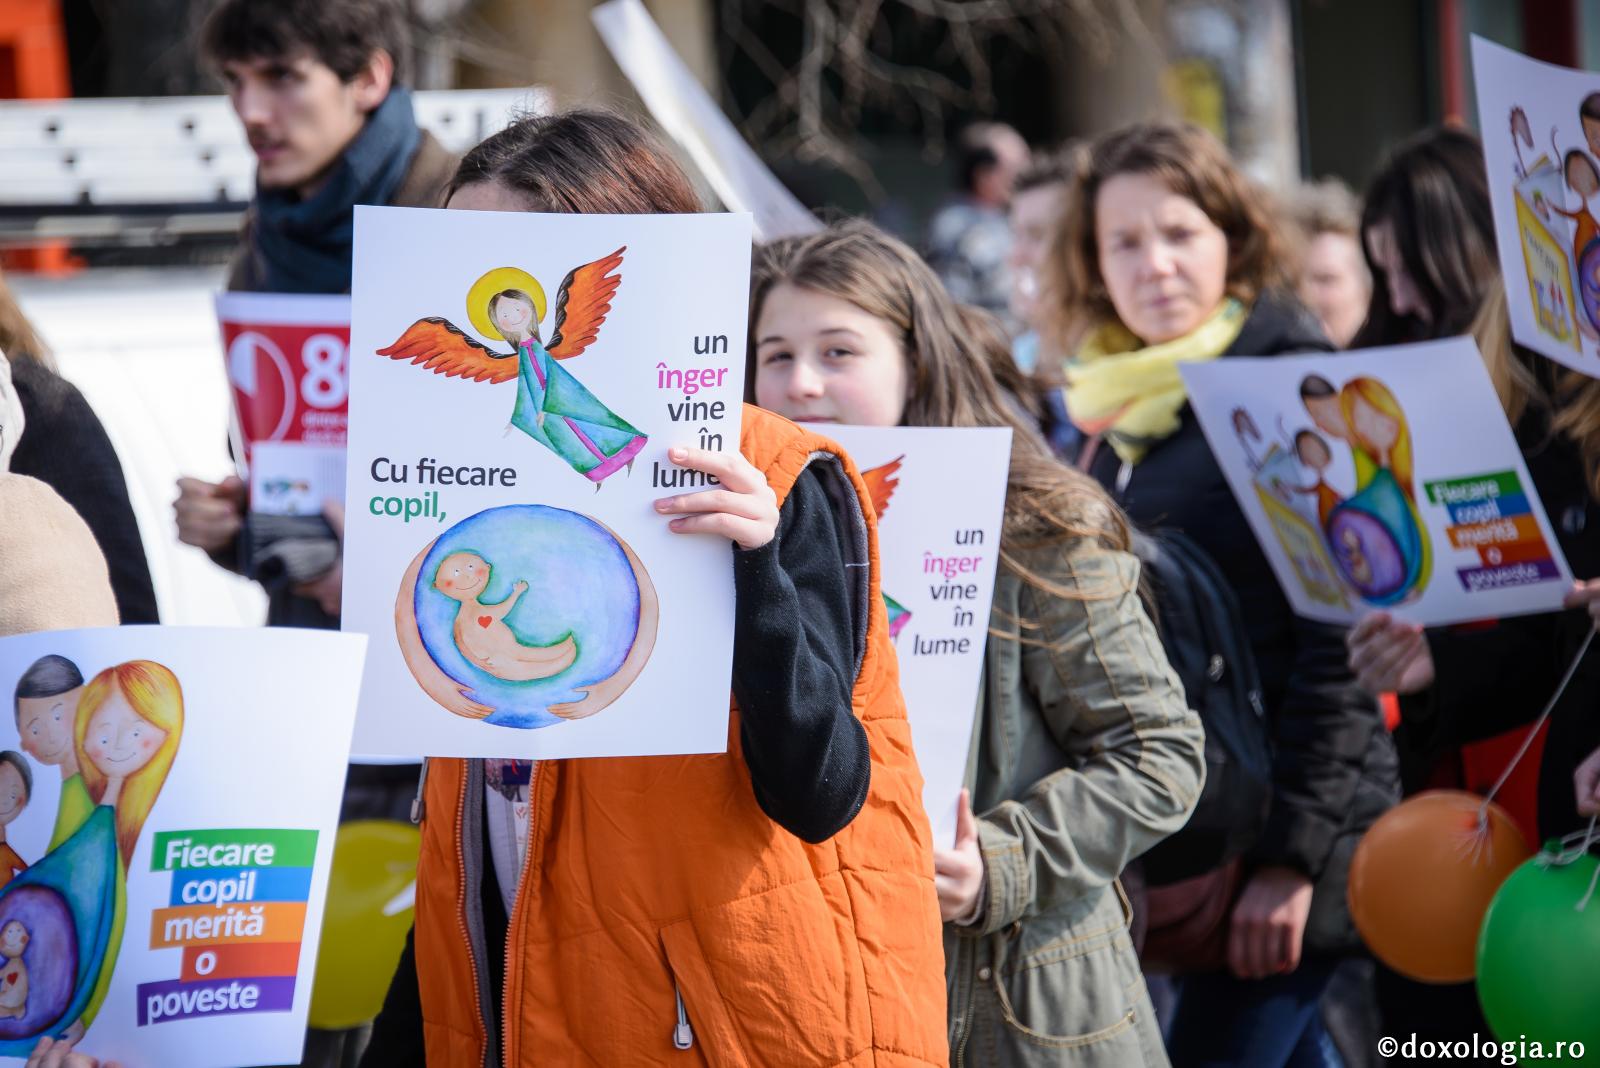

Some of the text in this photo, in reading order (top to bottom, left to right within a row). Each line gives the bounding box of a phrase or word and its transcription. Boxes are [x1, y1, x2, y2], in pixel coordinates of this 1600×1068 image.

[693, 334, 728, 355] un
[301, 333, 349, 409] 8
[656, 361, 729, 395] înger
[667, 396, 725, 422] vine
[698, 426, 723, 452] în
[370, 457, 517, 487] Cu fiecare
[1431, 479, 1500, 503] Fiecare
[369, 491, 447, 523] copil,
[1455, 498, 1501, 523] copil
[955, 529, 984, 545] un
[923, 550, 982, 579] înger
[1486, 546, 1503, 565] o
[930, 579, 977, 600] vine
[1467, 563, 1539, 592] poveste
[953, 606, 974, 627] în
[913, 634, 970, 656] lume
[164, 838, 275, 870] Fiecare
[181, 871, 257, 909] copil
[163, 906, 265, 942] merită
[194, 950, 217, 976] o
[147, 982, 260, 1025] poveste
